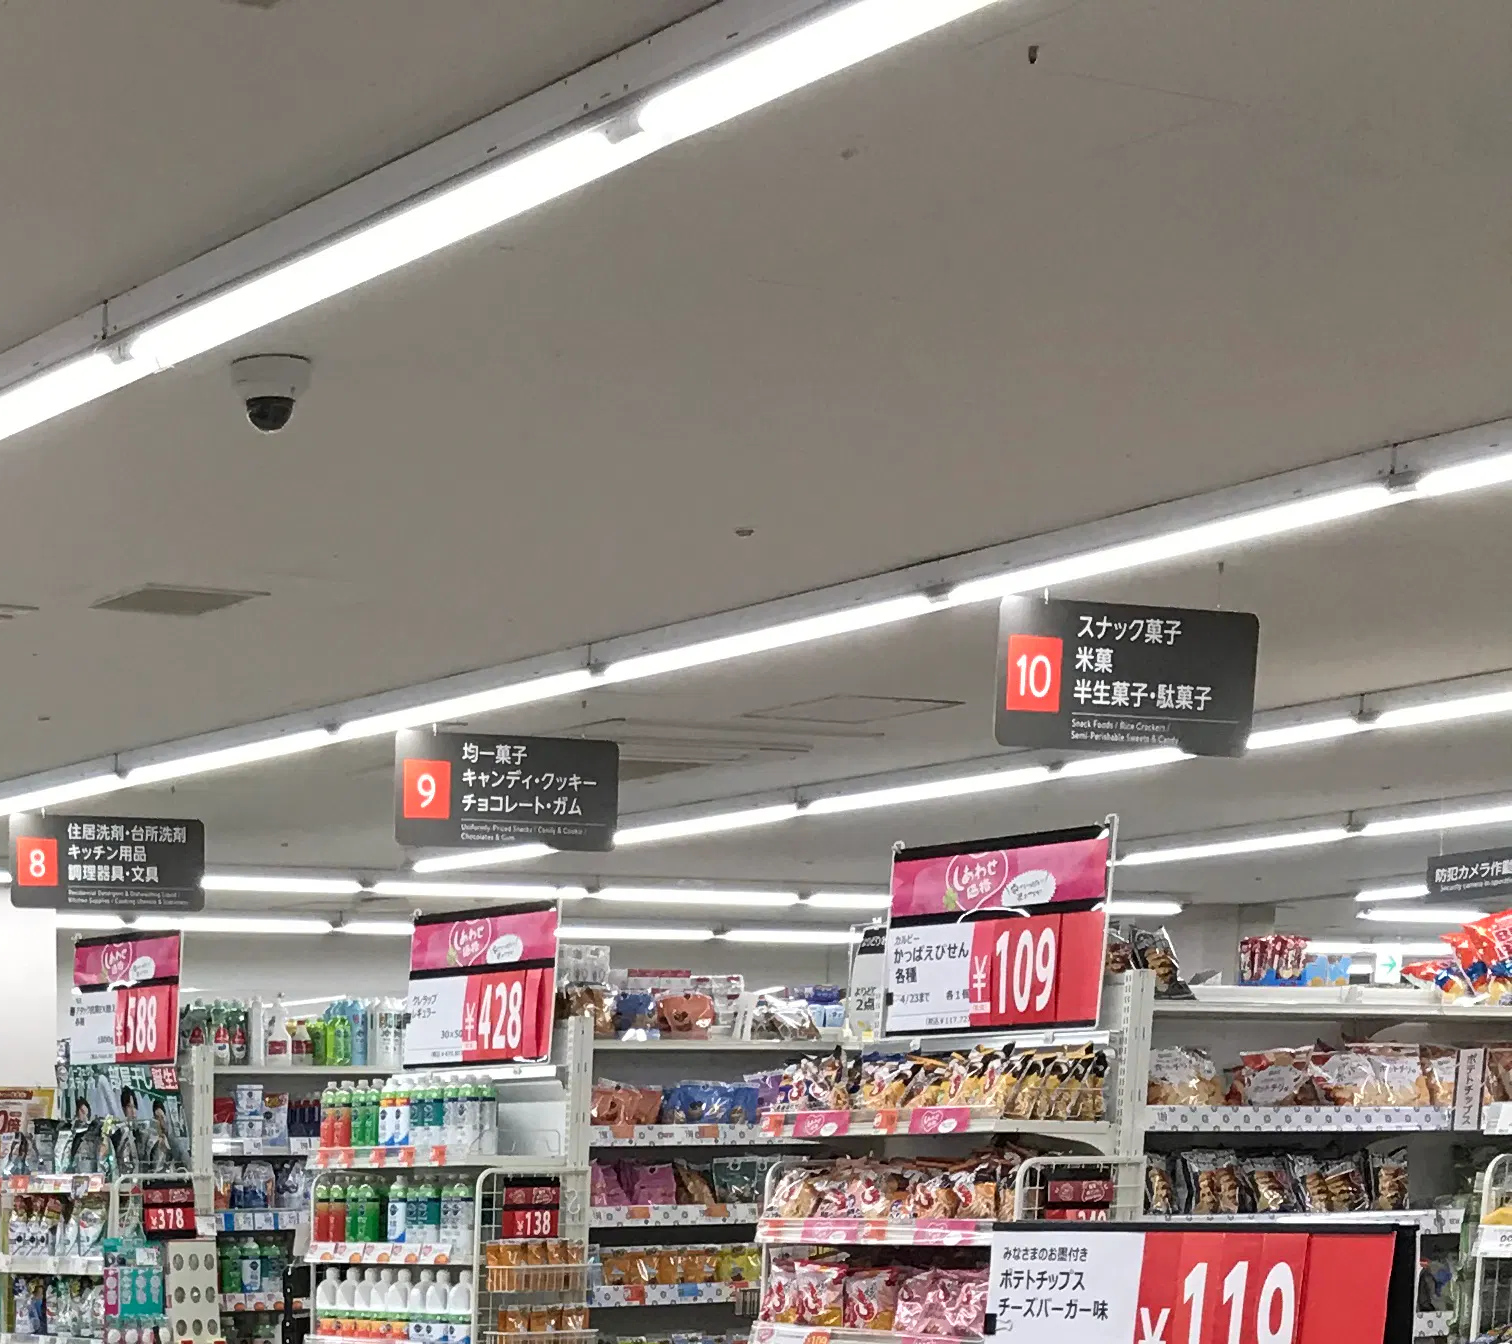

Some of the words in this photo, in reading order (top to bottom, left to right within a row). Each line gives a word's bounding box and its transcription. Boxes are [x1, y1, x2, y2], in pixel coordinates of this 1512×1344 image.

[1077, 615, 1182, 646] スナック菓子
[1075, 646, 1114, 674] 米菓
[1016, 654, 1052, 698] 10
[1073, 678, 1213, 711] 半生菓子・駄菓子
[461, 742, 528, 765] 均一菓子
[416, 773, 436, 808] 9
[461, 768, 597, 792] キャンディ・クッキー
[461, 793, 582, 816] チョコレート・ガム
[67, 823, 187, 843] 住居洗剤・台所洗剤
[29, 848, 46, 878] 8
[67, 844, 147, 862] キッチン用品
[67, 864, 159, 883] 調理器具・文具
[894, 935, 920, 945] カルビー
[893, 941, 969, 964] かっぱえびせん
[895, 966, 917, 984] 各種
[1002, 1246, 1089, 1263] みなさまのお墨付き
[999, 1270, 1086, 1291] ポテトチップス
[998, 1297, 1109, 1321] チーズバーガー味
